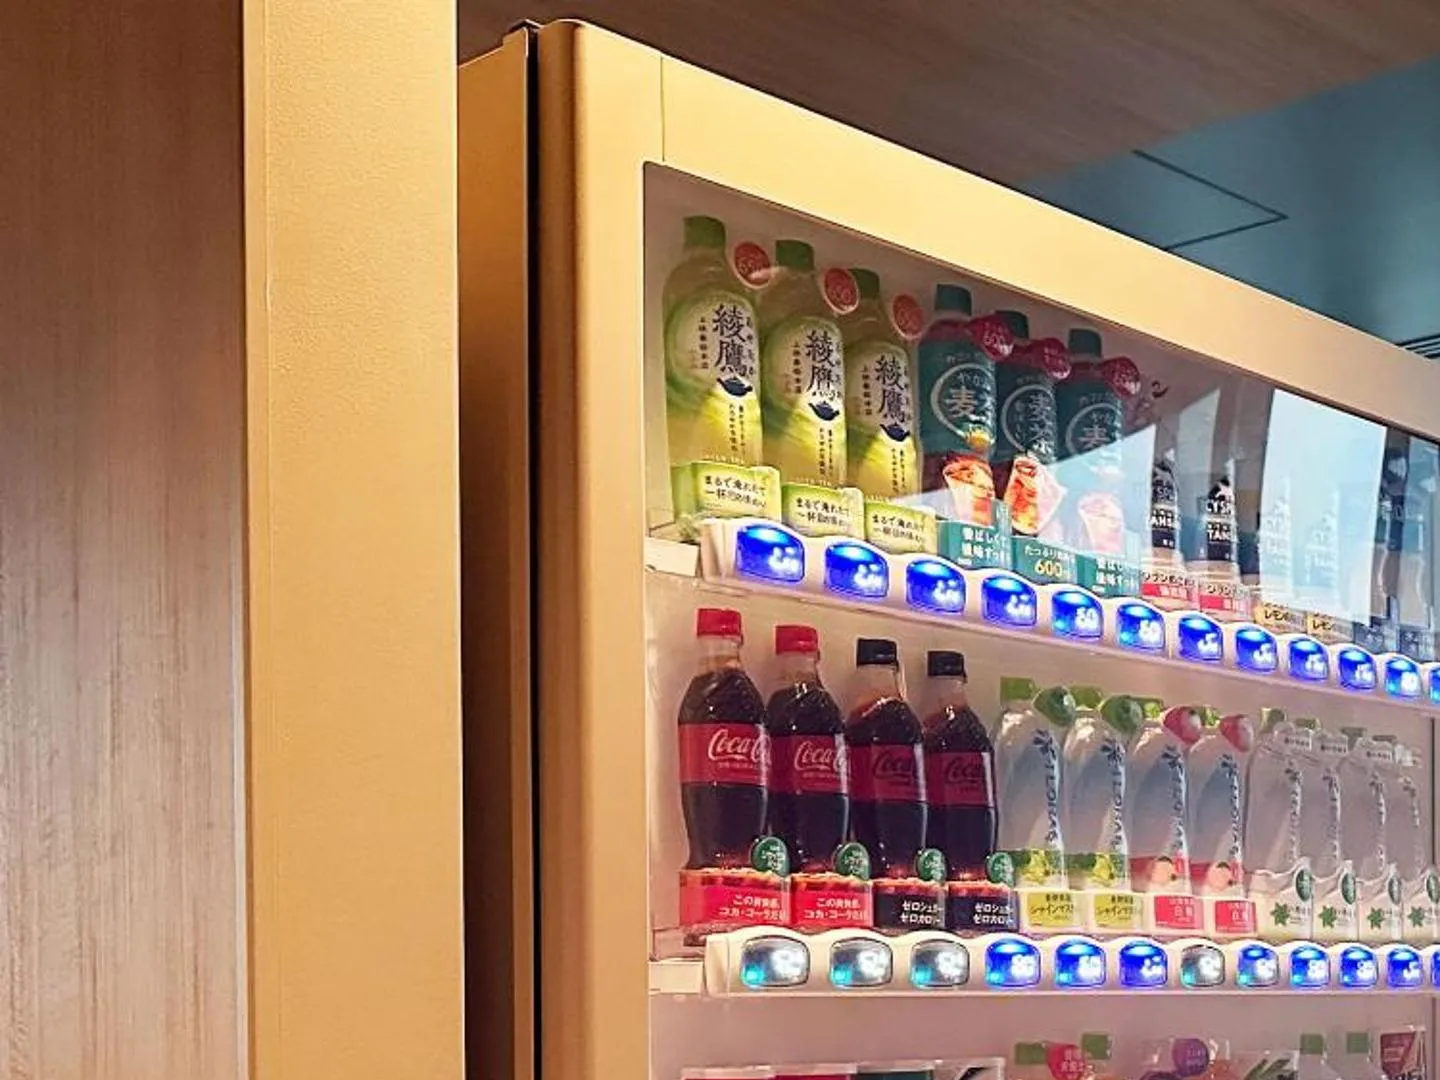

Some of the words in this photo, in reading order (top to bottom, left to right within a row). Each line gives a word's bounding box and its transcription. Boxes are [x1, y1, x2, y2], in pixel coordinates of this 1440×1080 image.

[712, 303, 747, 378] 綾鷹
[805, 329, 841, 401] 綾鷹
[873, 353, 907, 423] 綾鷹
